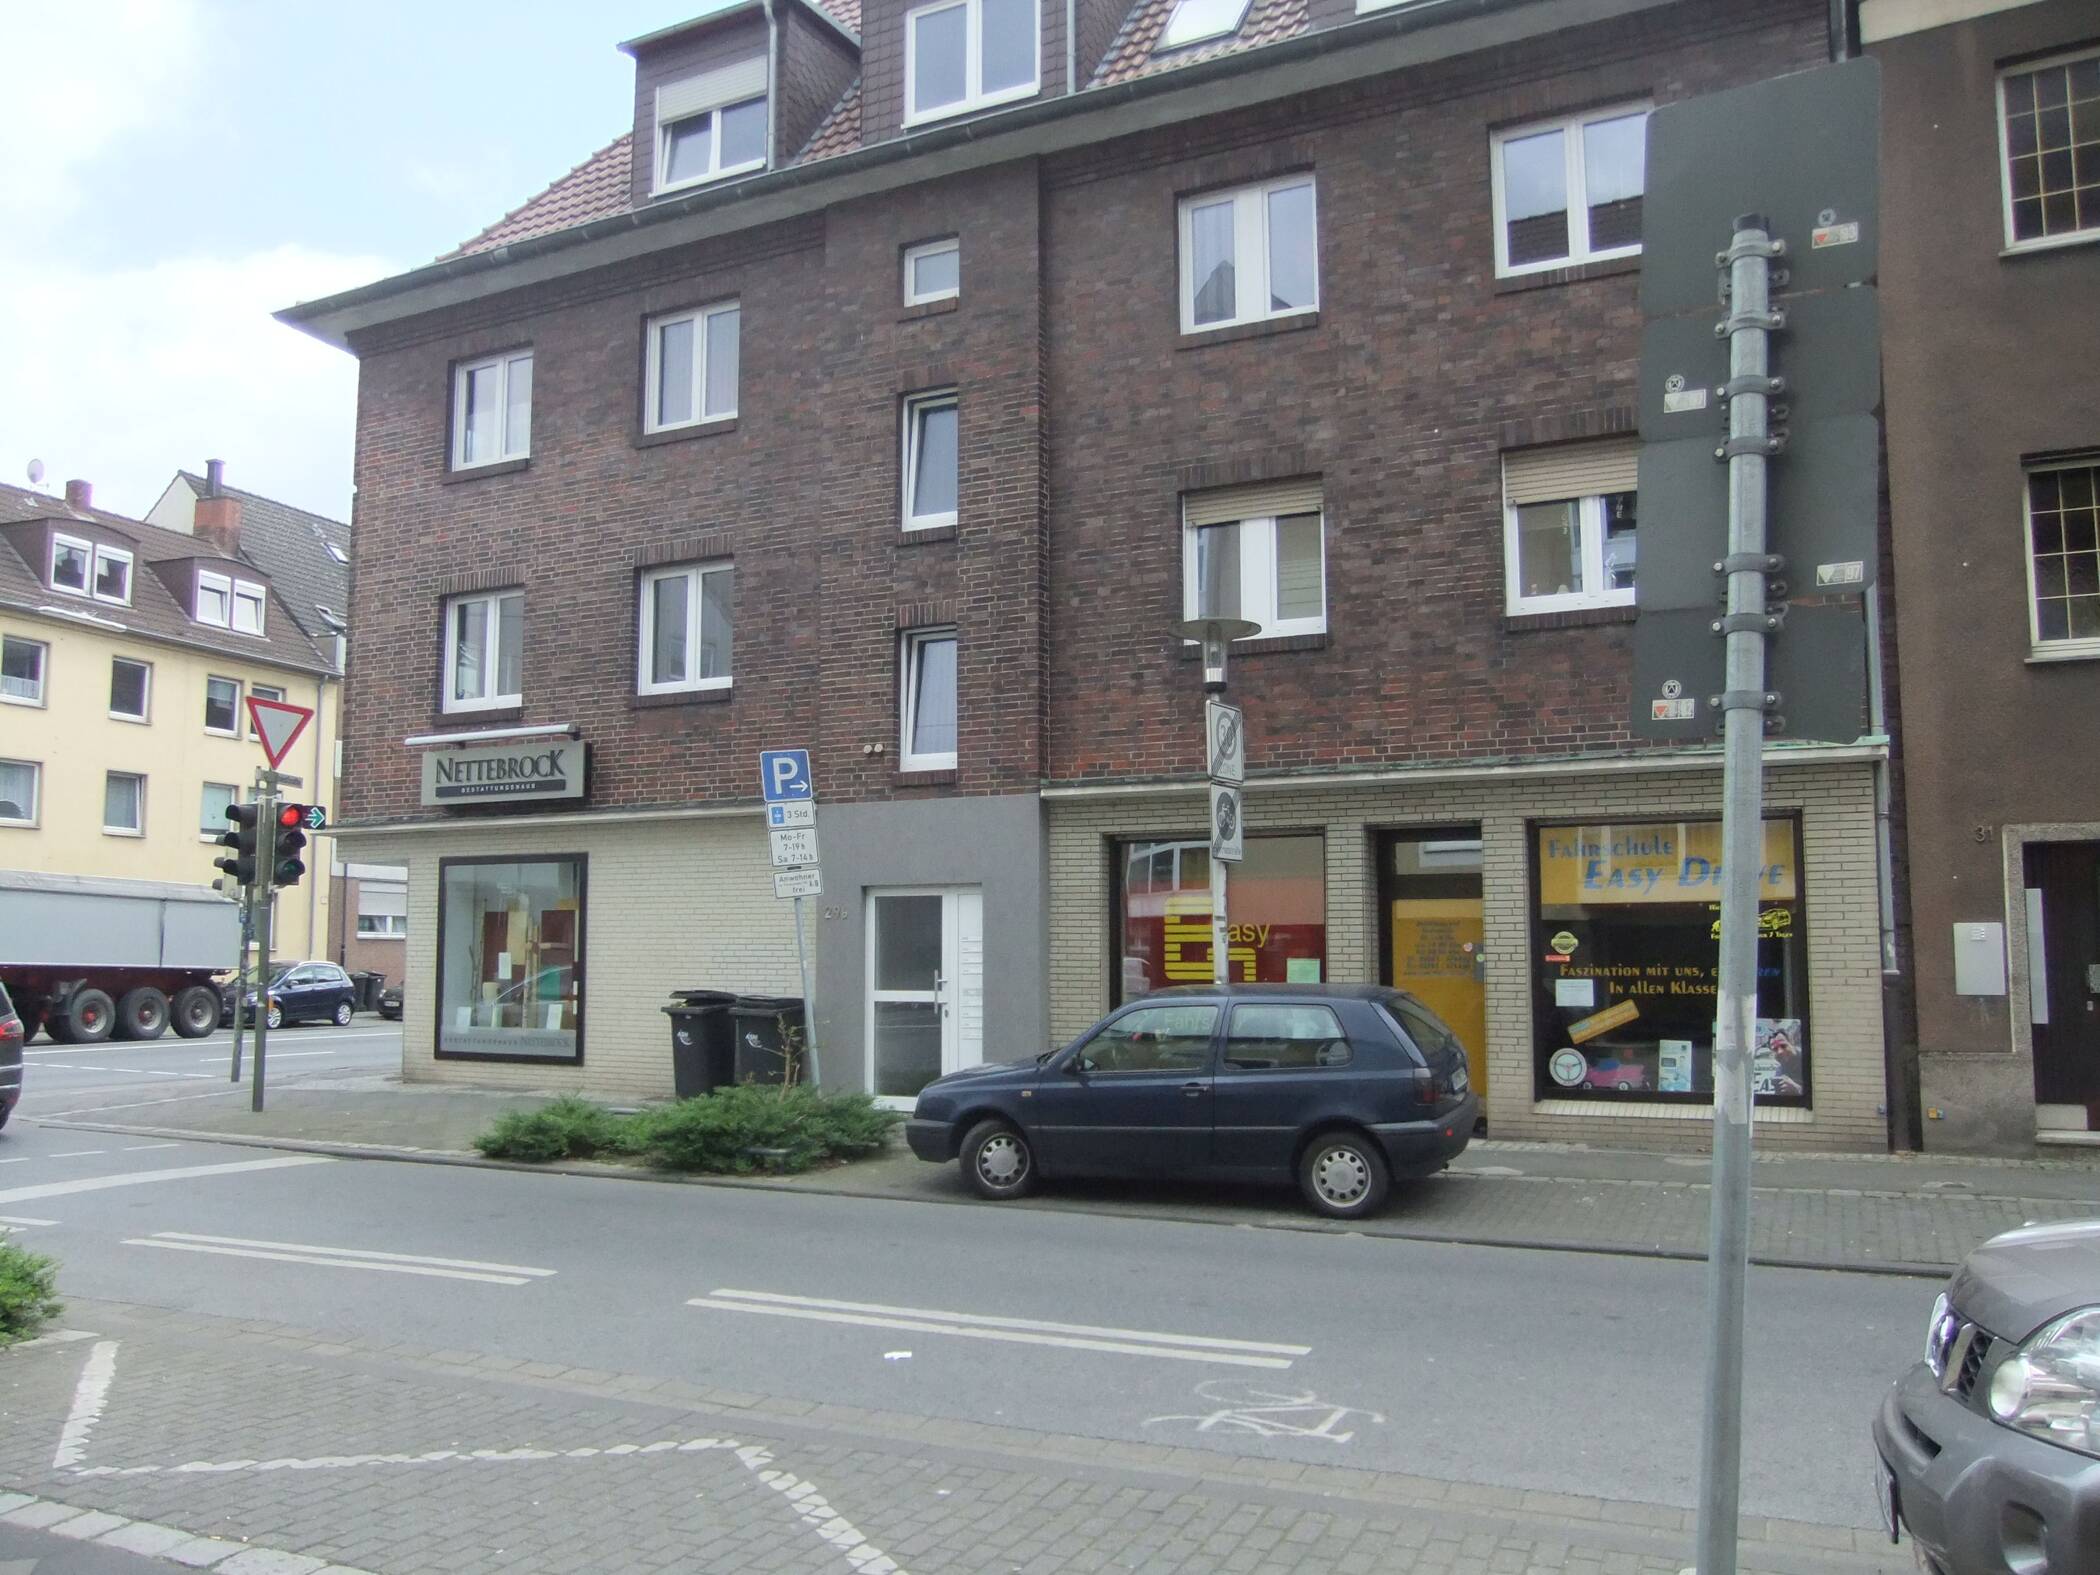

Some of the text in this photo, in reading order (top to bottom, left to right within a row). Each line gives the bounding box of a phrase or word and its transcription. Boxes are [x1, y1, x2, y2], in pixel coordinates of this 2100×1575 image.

[436, 749, 565, 783] NETTEBROCK
[773, 758, 798, 794] P
[786, 809, 808, 819] 3 Std
[780, 832, 805, 842] Mo-Fr
[1975, 825, 1993, 842] 31
[783, 843, 800, 851] 7-19
[791, 854, 807, 862] 7-14
[1646, 963, 1670, 976] mit
[1609, 980, 1718, 995] In allen Klasse
